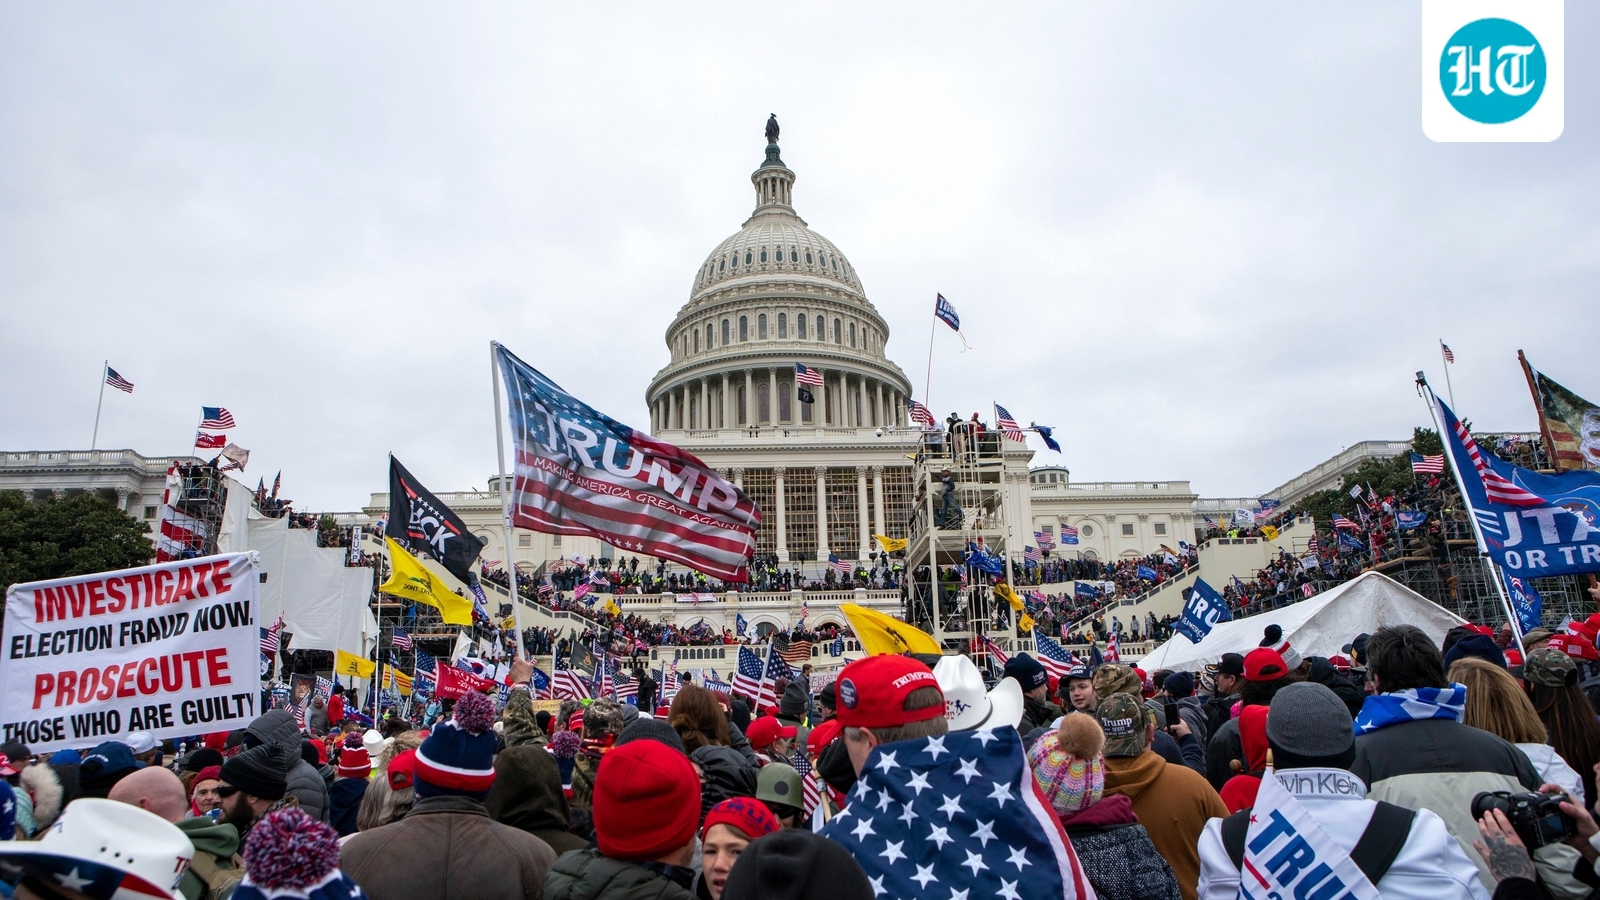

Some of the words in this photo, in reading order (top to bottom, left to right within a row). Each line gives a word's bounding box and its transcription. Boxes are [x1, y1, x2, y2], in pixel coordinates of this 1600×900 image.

[535, 402, 738, 512] TRUMP
[534, 457, 575, 482] MAKING
[576, 475, 632, 500] AMERICA
[635, 493, 687, 516] GREAT
[689, 513, 740, 531] AGAIN!
[352, 527, 361, 561] TRUMP
[34, 560, 233, 623] INVESTIGATE
[10, 624, 113, 660] ELECTION
[120, 612, 190, 647] FRAUD
[193, 600, 254, 633] NOW.
[32, 647, 232, 710] PROSECUTE
[705, 681, 731, 694] TRUMP
[892, 671, 924, 689] TRUMP
[2, 717, 66, 745] THOSE
[71, 709, 122, 738] WHO
[128, 703, 175, 732] ARE
[181, 693, 254, 725] GUILTY
[1102, 717, 1132, 728] Trump
[1317, 773, 1358, 795] Klein
